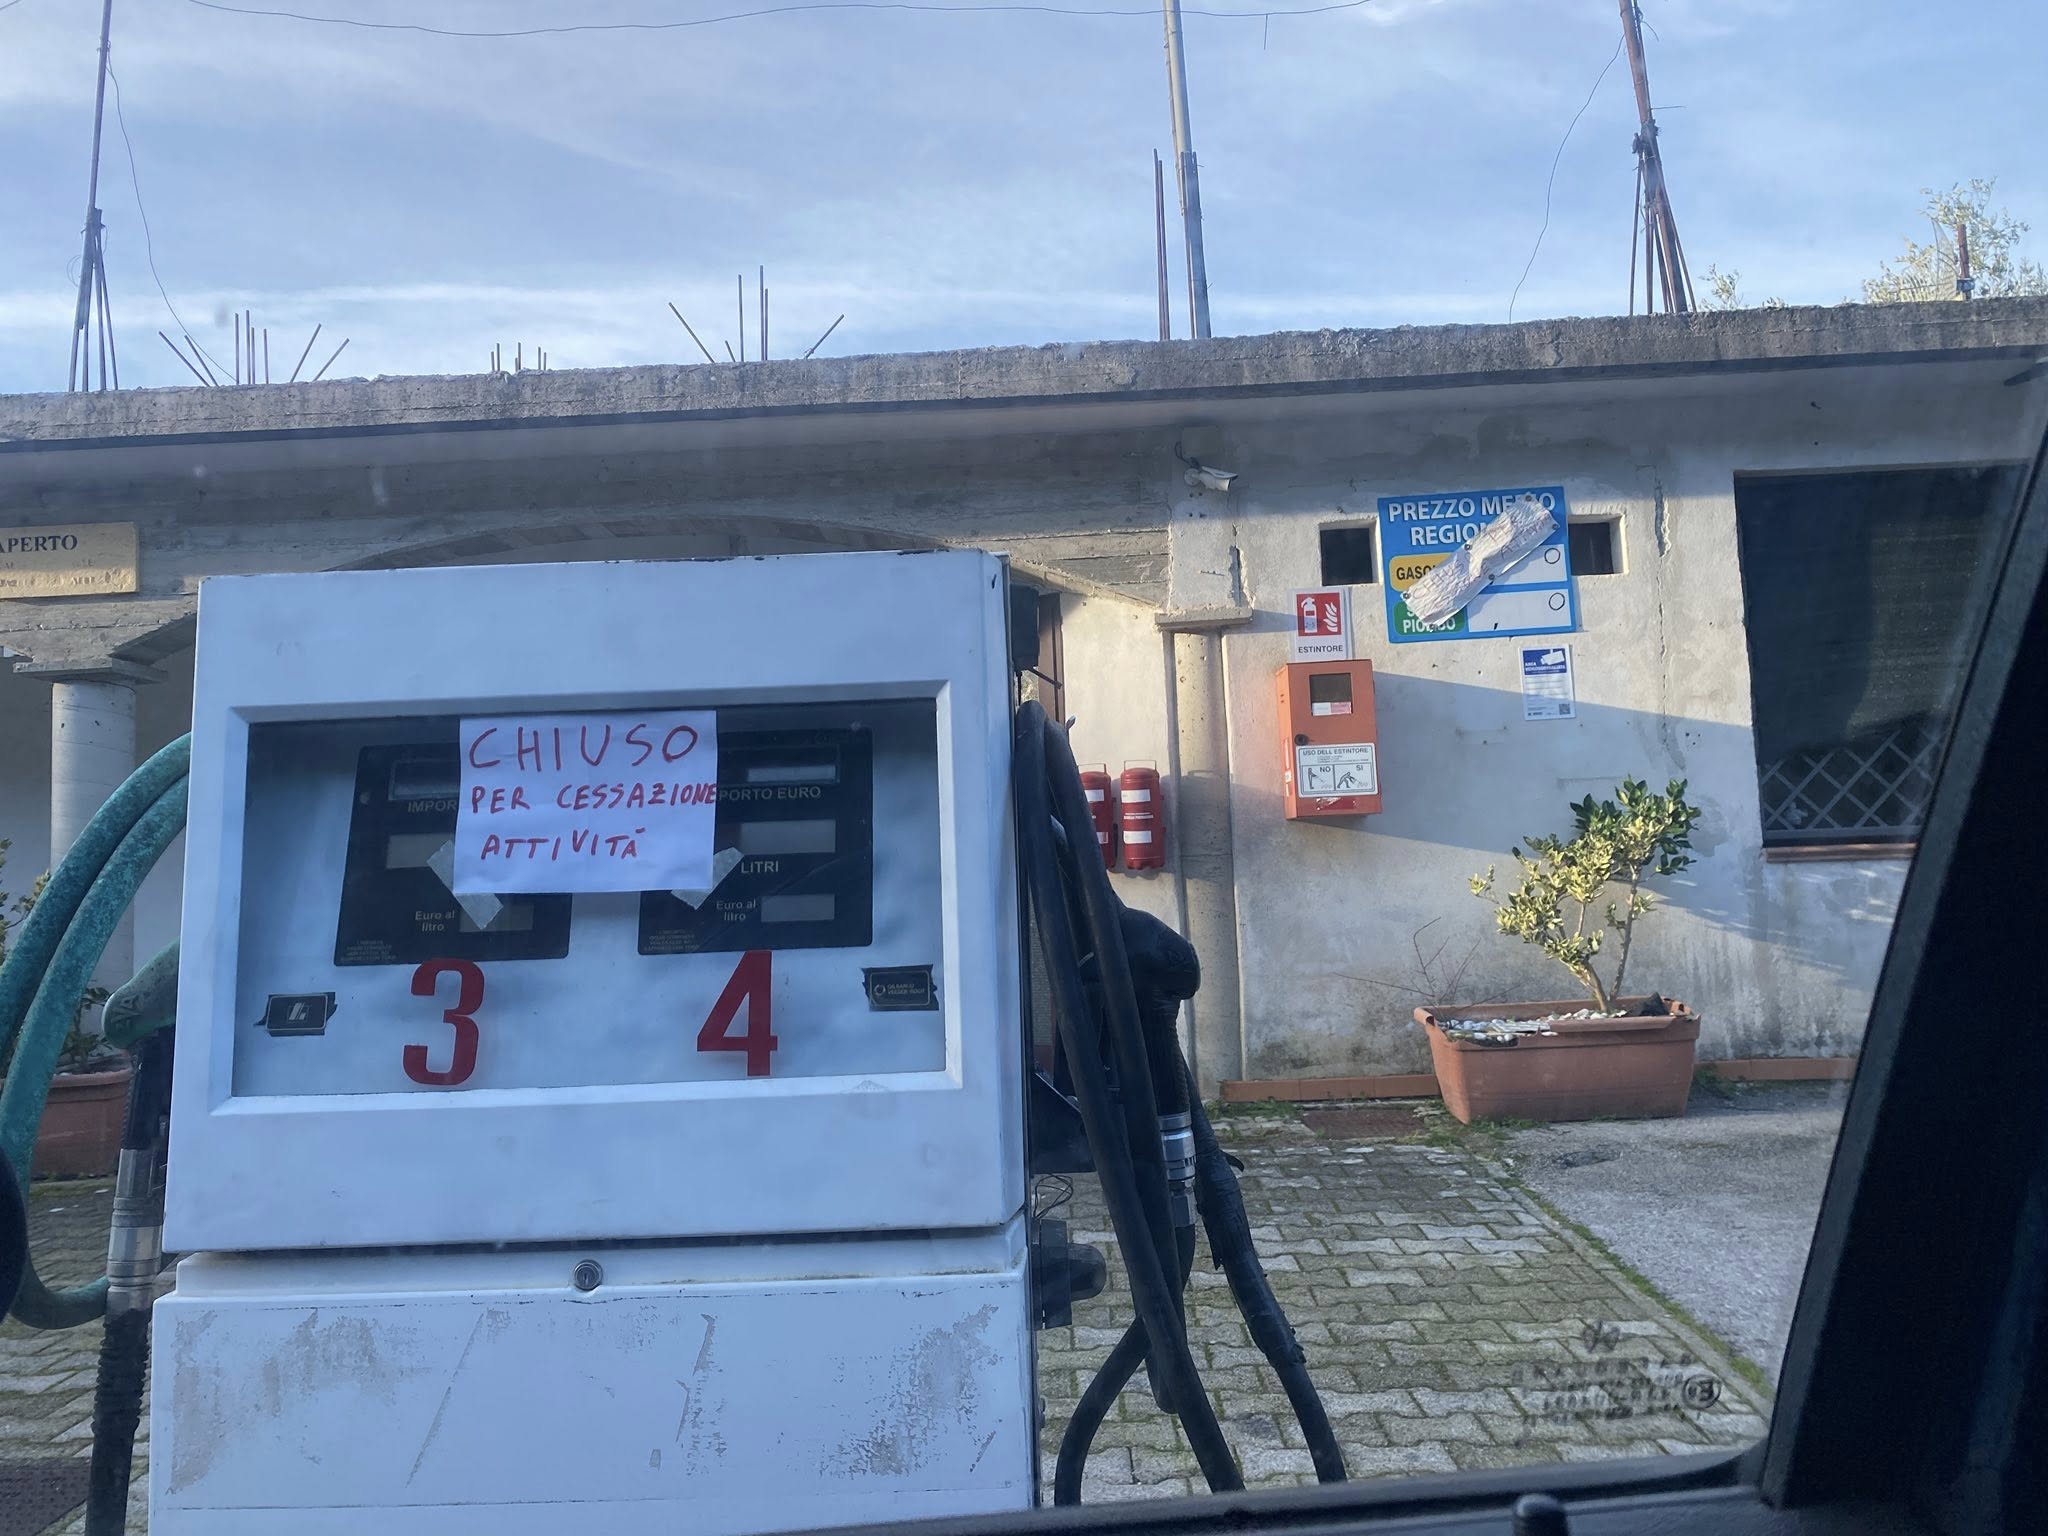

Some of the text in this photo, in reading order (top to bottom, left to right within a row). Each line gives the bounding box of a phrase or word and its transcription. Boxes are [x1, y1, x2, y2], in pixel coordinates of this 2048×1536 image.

[1389, 493, 1556, 522] PREZZO MEO
[1396, 564, 1436, 581] GASO
[1298, 645, 1344, 654] ESTINTORE
[469, 724, 698, 772] CHIUSO
[1334, 747, 1369, 755] ESTINTORE
[471, 782, 718, 813] PER CESSAZIONE
[720, 786, 821, 801] PORTO EURO
[407, 799, 458, 813] IMPOR
[741, 860, 779, 873] LITRI
[716, 898, 756, 910] Euro al
[415, 909, 455, 920] Euro al
[724, 911, 746, 921] litro
[422, 922, 445, 932] litro
[696, 949, 778, 1077] 4
[403, 957, 485, 1085] 3
